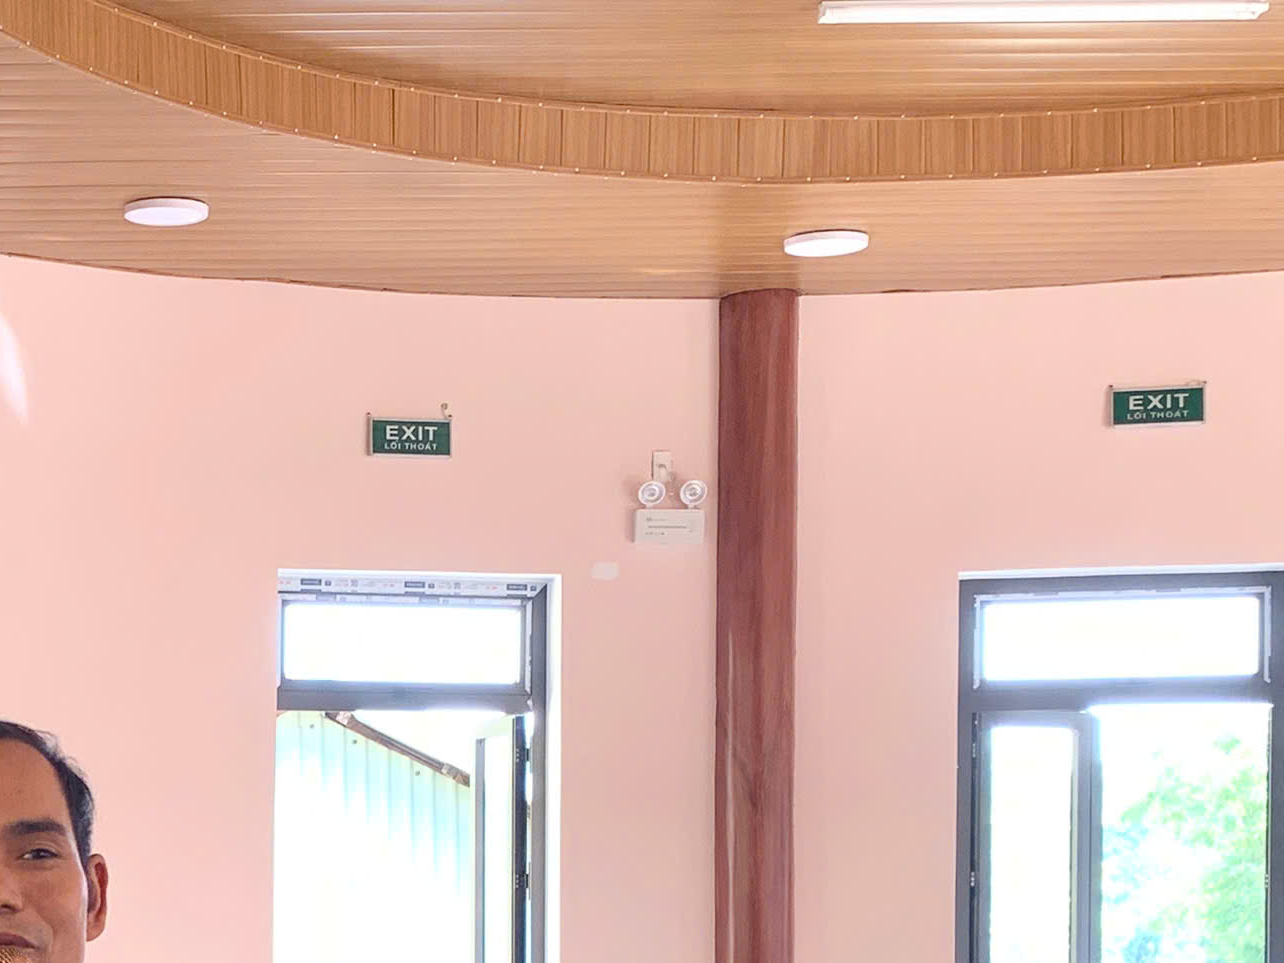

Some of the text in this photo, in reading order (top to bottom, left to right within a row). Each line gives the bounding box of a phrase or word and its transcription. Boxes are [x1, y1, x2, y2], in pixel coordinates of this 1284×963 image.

[1128, 393, 1189, 410] EXIT
[1149, 409, 1189, 419] THOÁT
[385, 425, 438, 441] EXIT
[404, 441, 437, 451] THOÁT
